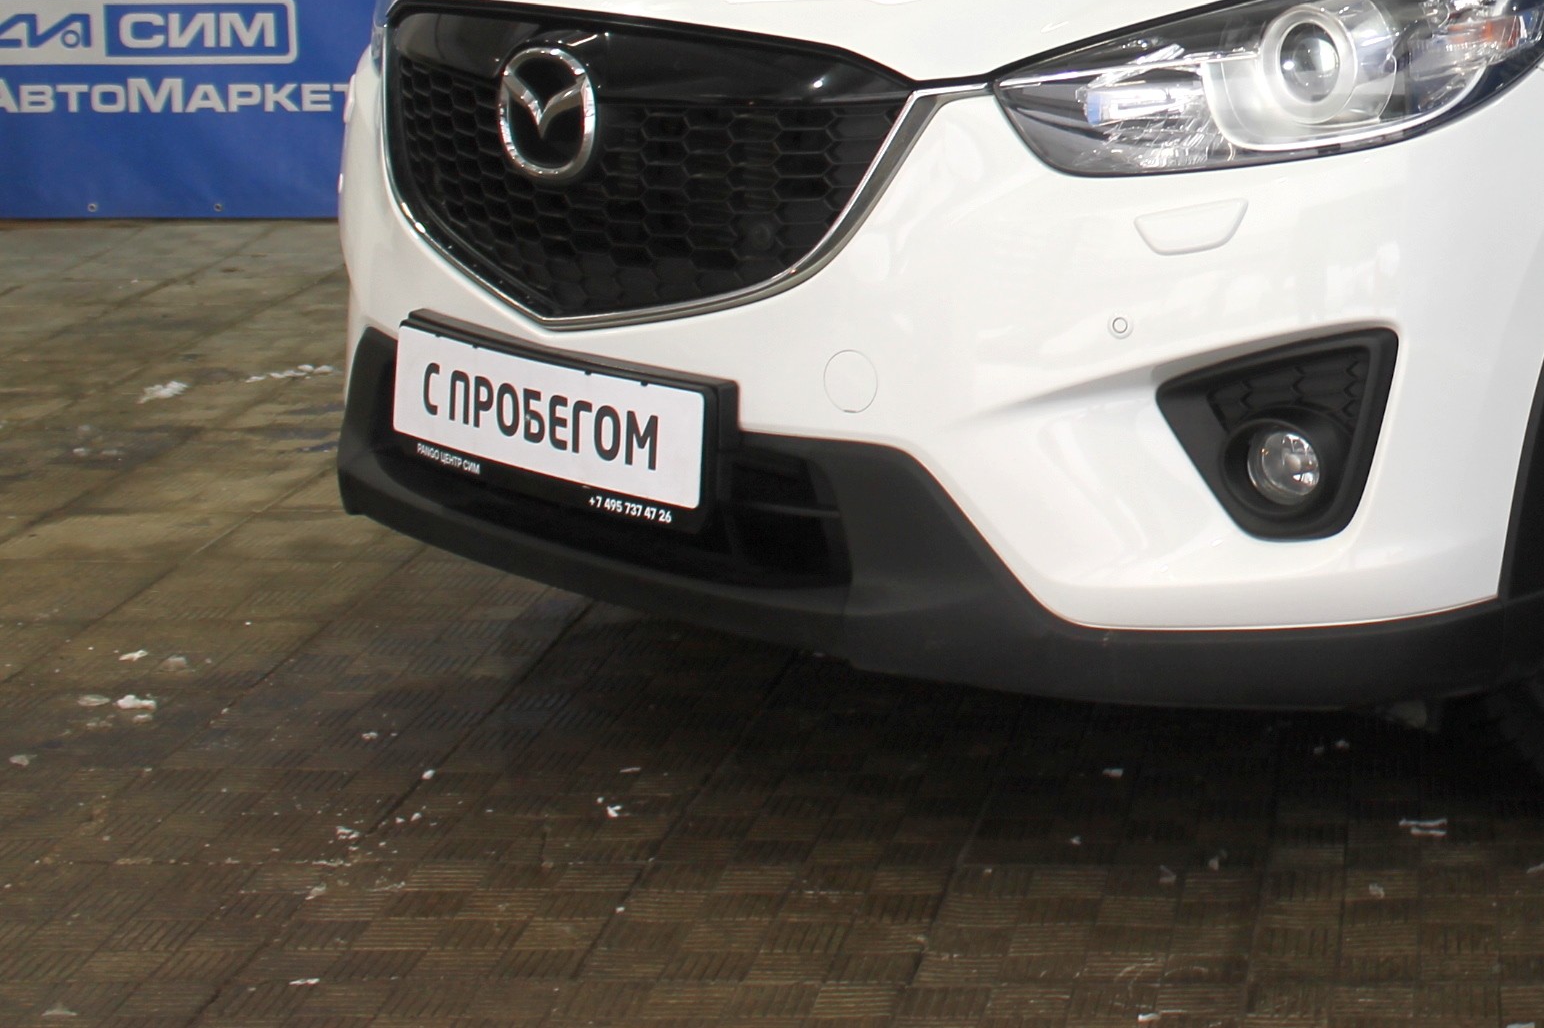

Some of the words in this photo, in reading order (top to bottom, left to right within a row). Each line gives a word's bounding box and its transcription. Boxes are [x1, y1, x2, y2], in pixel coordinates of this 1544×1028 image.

[119, 12, 276, 49] СИМ
[422, 362, 441, 416] С
[448, 369, 659, 471] ПРОБЕГОМ
[416, 442, 440, 460] PANGO
[440, 452, 463, 468] ЦЕНТР
[463, 459, 481, 475] СИМ
[589, 495, 603, 508] +7
[604, 497, 623, 513] 495
[624, 502, 643, 517] 737
[644, 506, 657, 520] 47
[658, 509, 672, 524] 26
